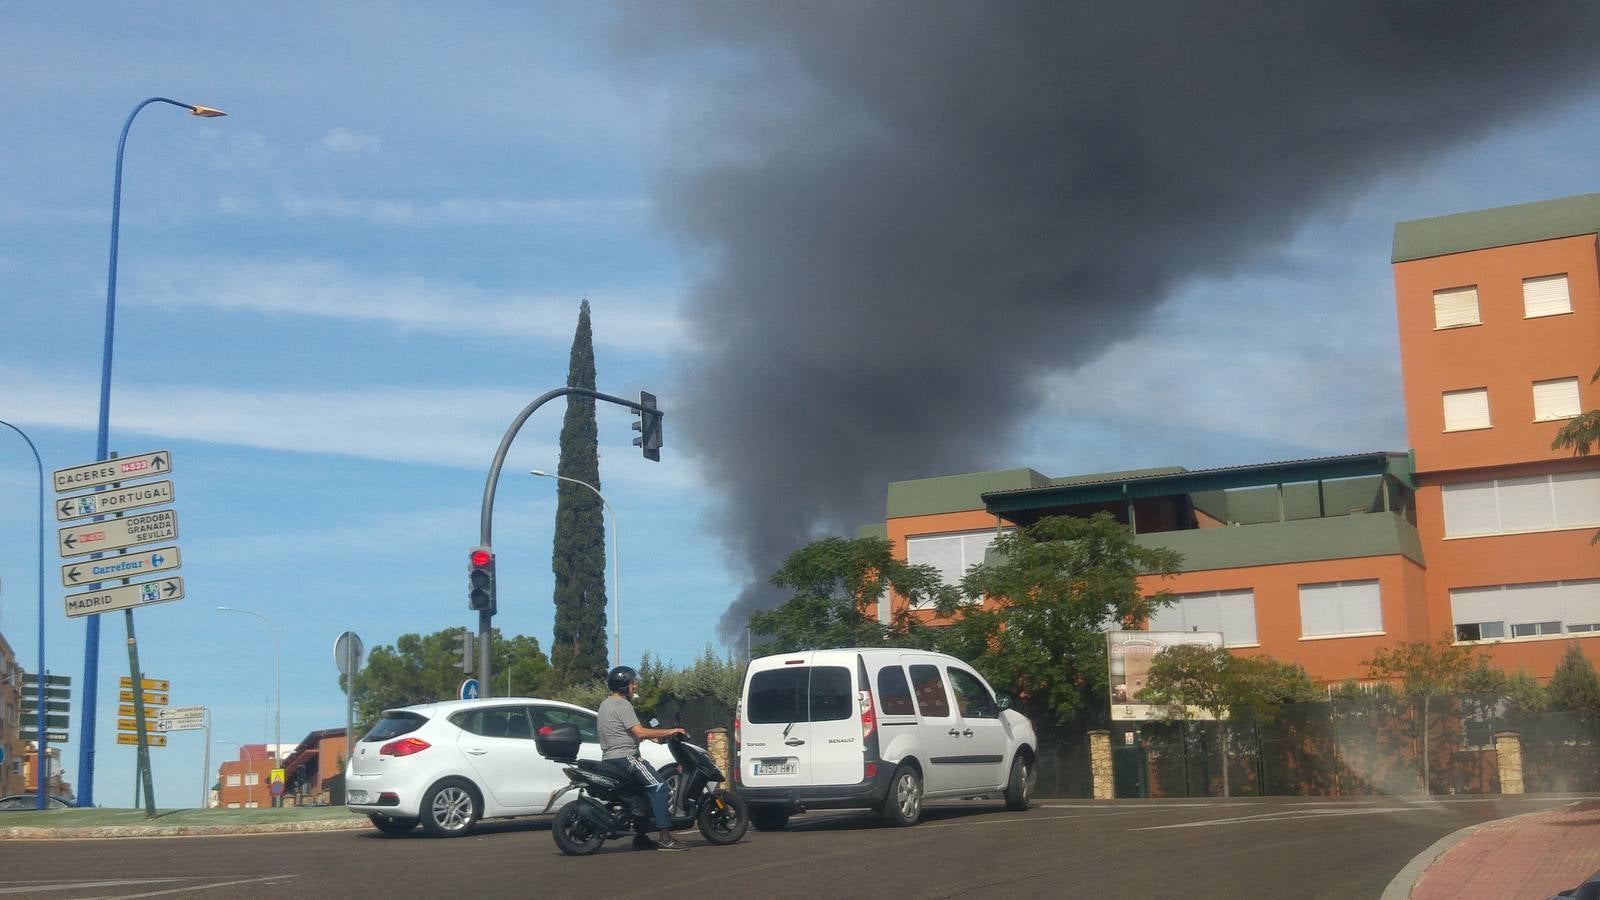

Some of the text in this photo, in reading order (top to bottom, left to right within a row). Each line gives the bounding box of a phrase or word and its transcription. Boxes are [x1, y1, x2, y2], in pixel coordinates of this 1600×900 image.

[58, 467, 116, 485] CACERES
[101, 488, 169, 507] PORTUGAL
[127, 512, 171, 527] CORDOBA
[127, 521, 172, 535] GRANADA
[136, 530, 173, 542] SEVILLA
[92, 560, 144, 575] Carrefour
[68, 595, 112, 610] MADRID
